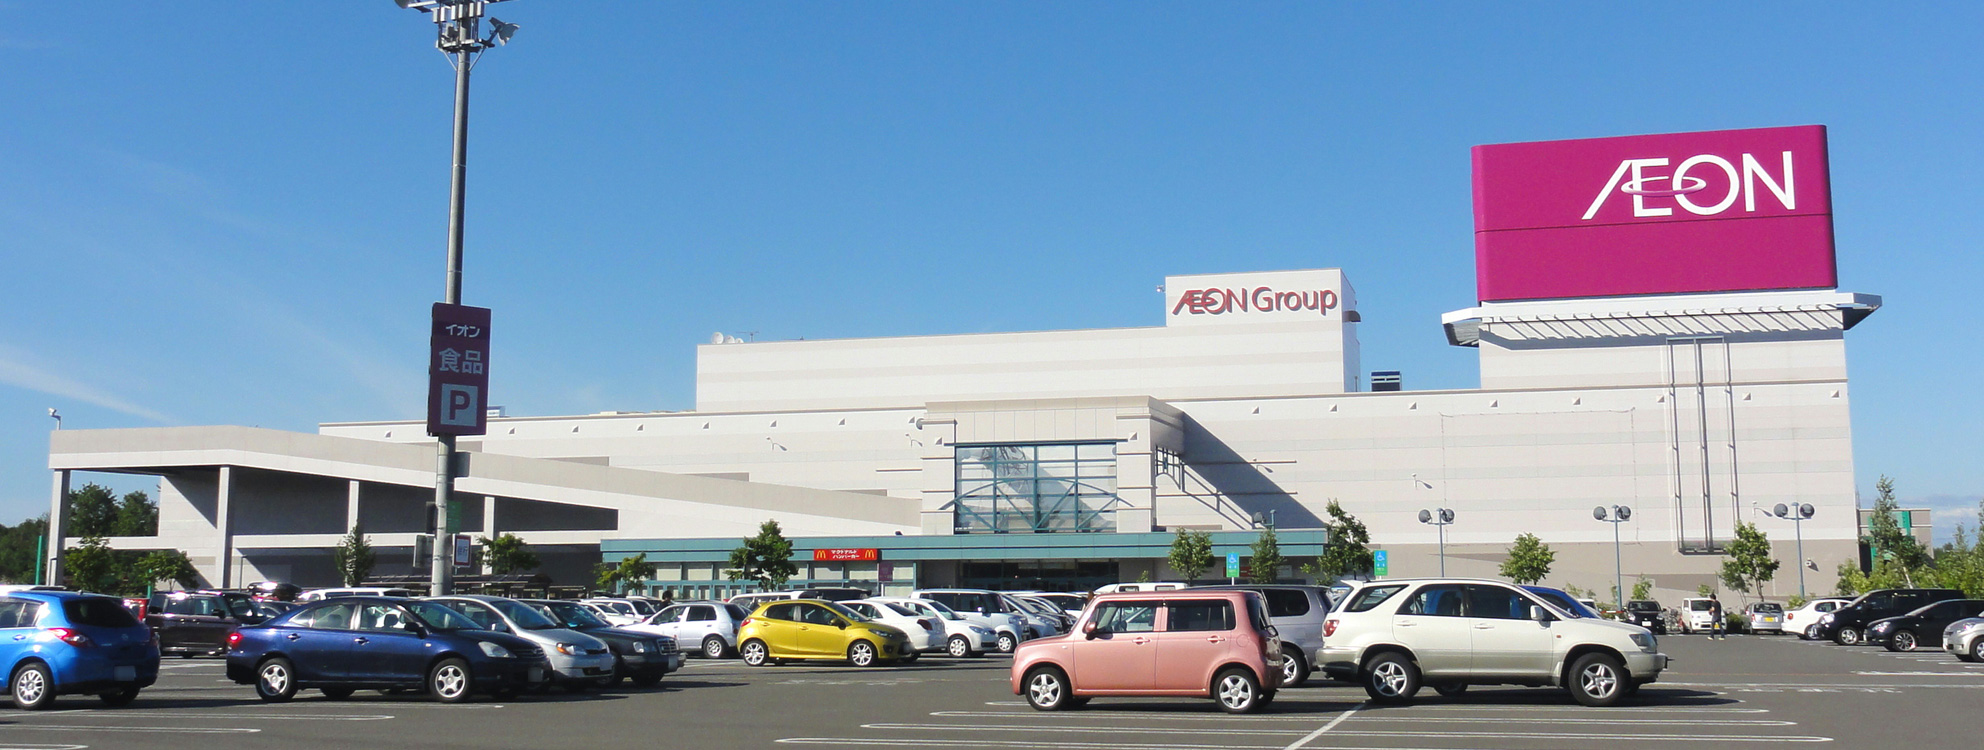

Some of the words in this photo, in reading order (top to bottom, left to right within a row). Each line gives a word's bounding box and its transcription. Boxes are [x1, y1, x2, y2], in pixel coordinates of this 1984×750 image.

[1252, 286, 1338, 316] Group
[445, 324, 481, 338] イオン
[438, 347, 484, 375] 食品
[449, 389, 471, 421] P
